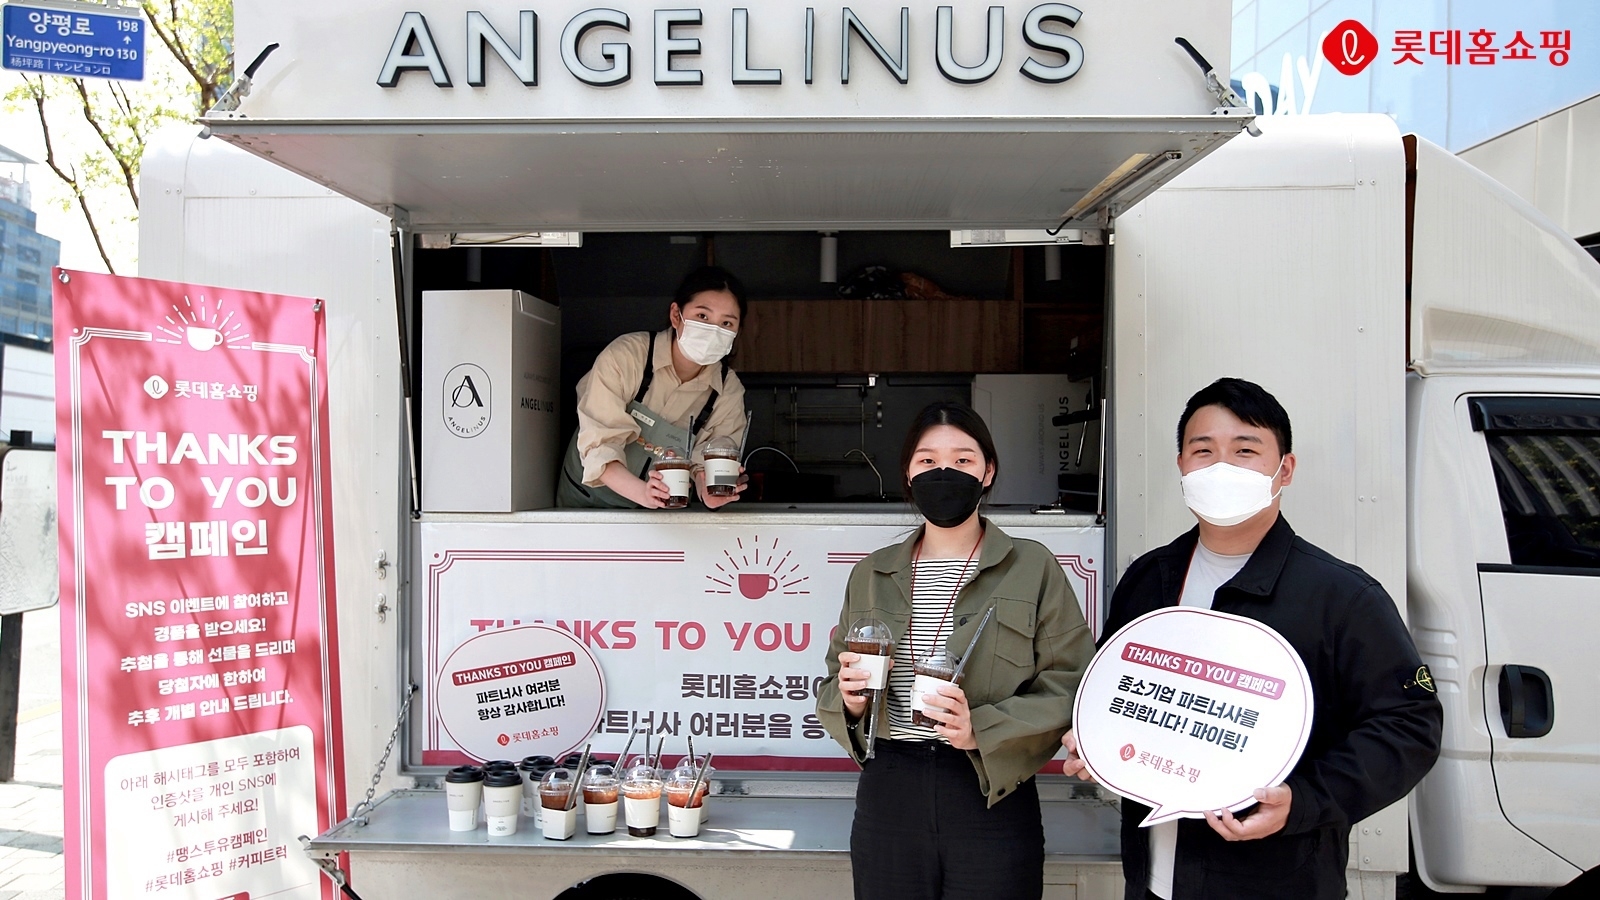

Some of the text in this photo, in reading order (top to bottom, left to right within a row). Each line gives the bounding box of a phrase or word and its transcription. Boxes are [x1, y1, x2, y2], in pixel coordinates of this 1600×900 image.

[29, 12, 95, 36] 양평로
[117, 20, 139, 33] 198
[6, 34, 115, 58] Yangpyeong-ro
[117, 48, 138, 61] 130
[376, 2, 1084, 88] ANGELINUS
[173, 380, 258, 402] 롯데홈쇼핑
[520, 396, 554, 413] ANGELINUS
[447, 415, 486, 434] ANGELINUS
[102, 430, 297, 466] THANKS
[105, 476, 297, 510] TO YOU
[145, 520, 268, 560] 캠페인
[125, 600, 166, 618] SNS
[170, 595, 230, 614] 이벤트에
[154, 618, 266, 643] 경품을 받으세요!
[655, 621, 706, 650] TO
[724, 622, 811, 652] YOU
[120, 639, 296, 673] 추첨을 통해 선물을 드리며
[456, 654, 572, 684] THANKS TO YOU 캠페인
[1126, 645, 1279, 697] THANKS TO YOU 캠페인
[158, 667, 266, 696] 당첨자에 한하여
[476, 679, 561, 704] 파트너사 여러분
[128, 689, 294, 727] 추후 개별 안내 드립니다.
[477, 695, 566, 721] 항상 감사합니다!
[1117, 675, 1260, 729] 중소기업 파트너사를
[512, 726, 559, 743] 롯데홈쇼핑
[690, 712, 793, 739] 여러분을
[1108, 697, 1249, 753] 응원합니다! 파이팅!
[120, 747, 300, 792] 아래 해시태그를 모두 포함하여
[1137, 750, 1201, 784] 롯데홈쇼핑
[151, 772, 277, 811] 인증샷을 개인 SNS에
[173, 798, 259, 828] 게시해 주세요!
[167, 828, 269, 864] #땡스투유캠페인
[145, 845, 288, 893] #롯데홈쇼핑 #커피트럭
